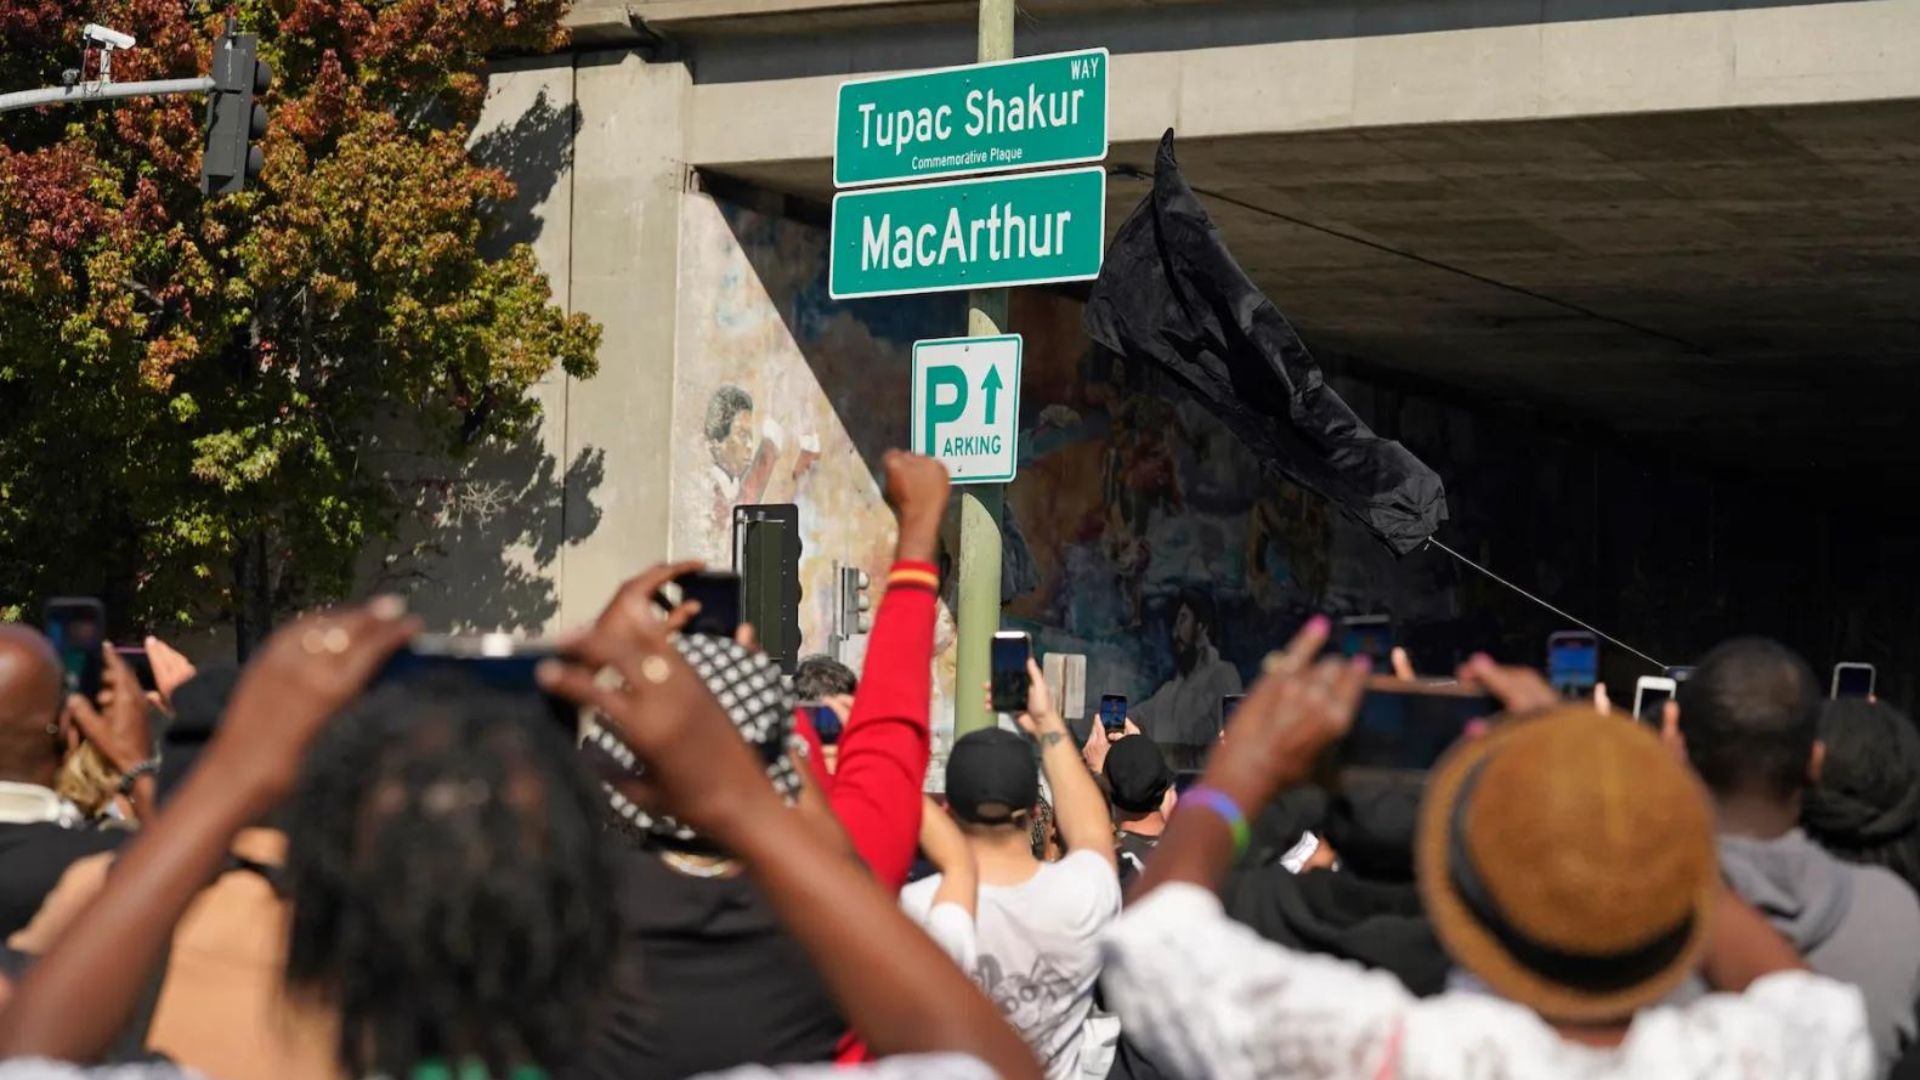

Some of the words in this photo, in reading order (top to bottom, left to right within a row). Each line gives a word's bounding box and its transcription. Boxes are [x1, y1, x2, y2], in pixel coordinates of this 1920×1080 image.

[1071, 57, 1099, 80] WAY
[858, 102, 952, 156] Tupac
[964, 83, 1084, 137] Shakur
[911, 151, 987, 170] Commemorative
[990, 147, 1022, 163] Plaque
[861, 202, 1071, 271] MacArthur
